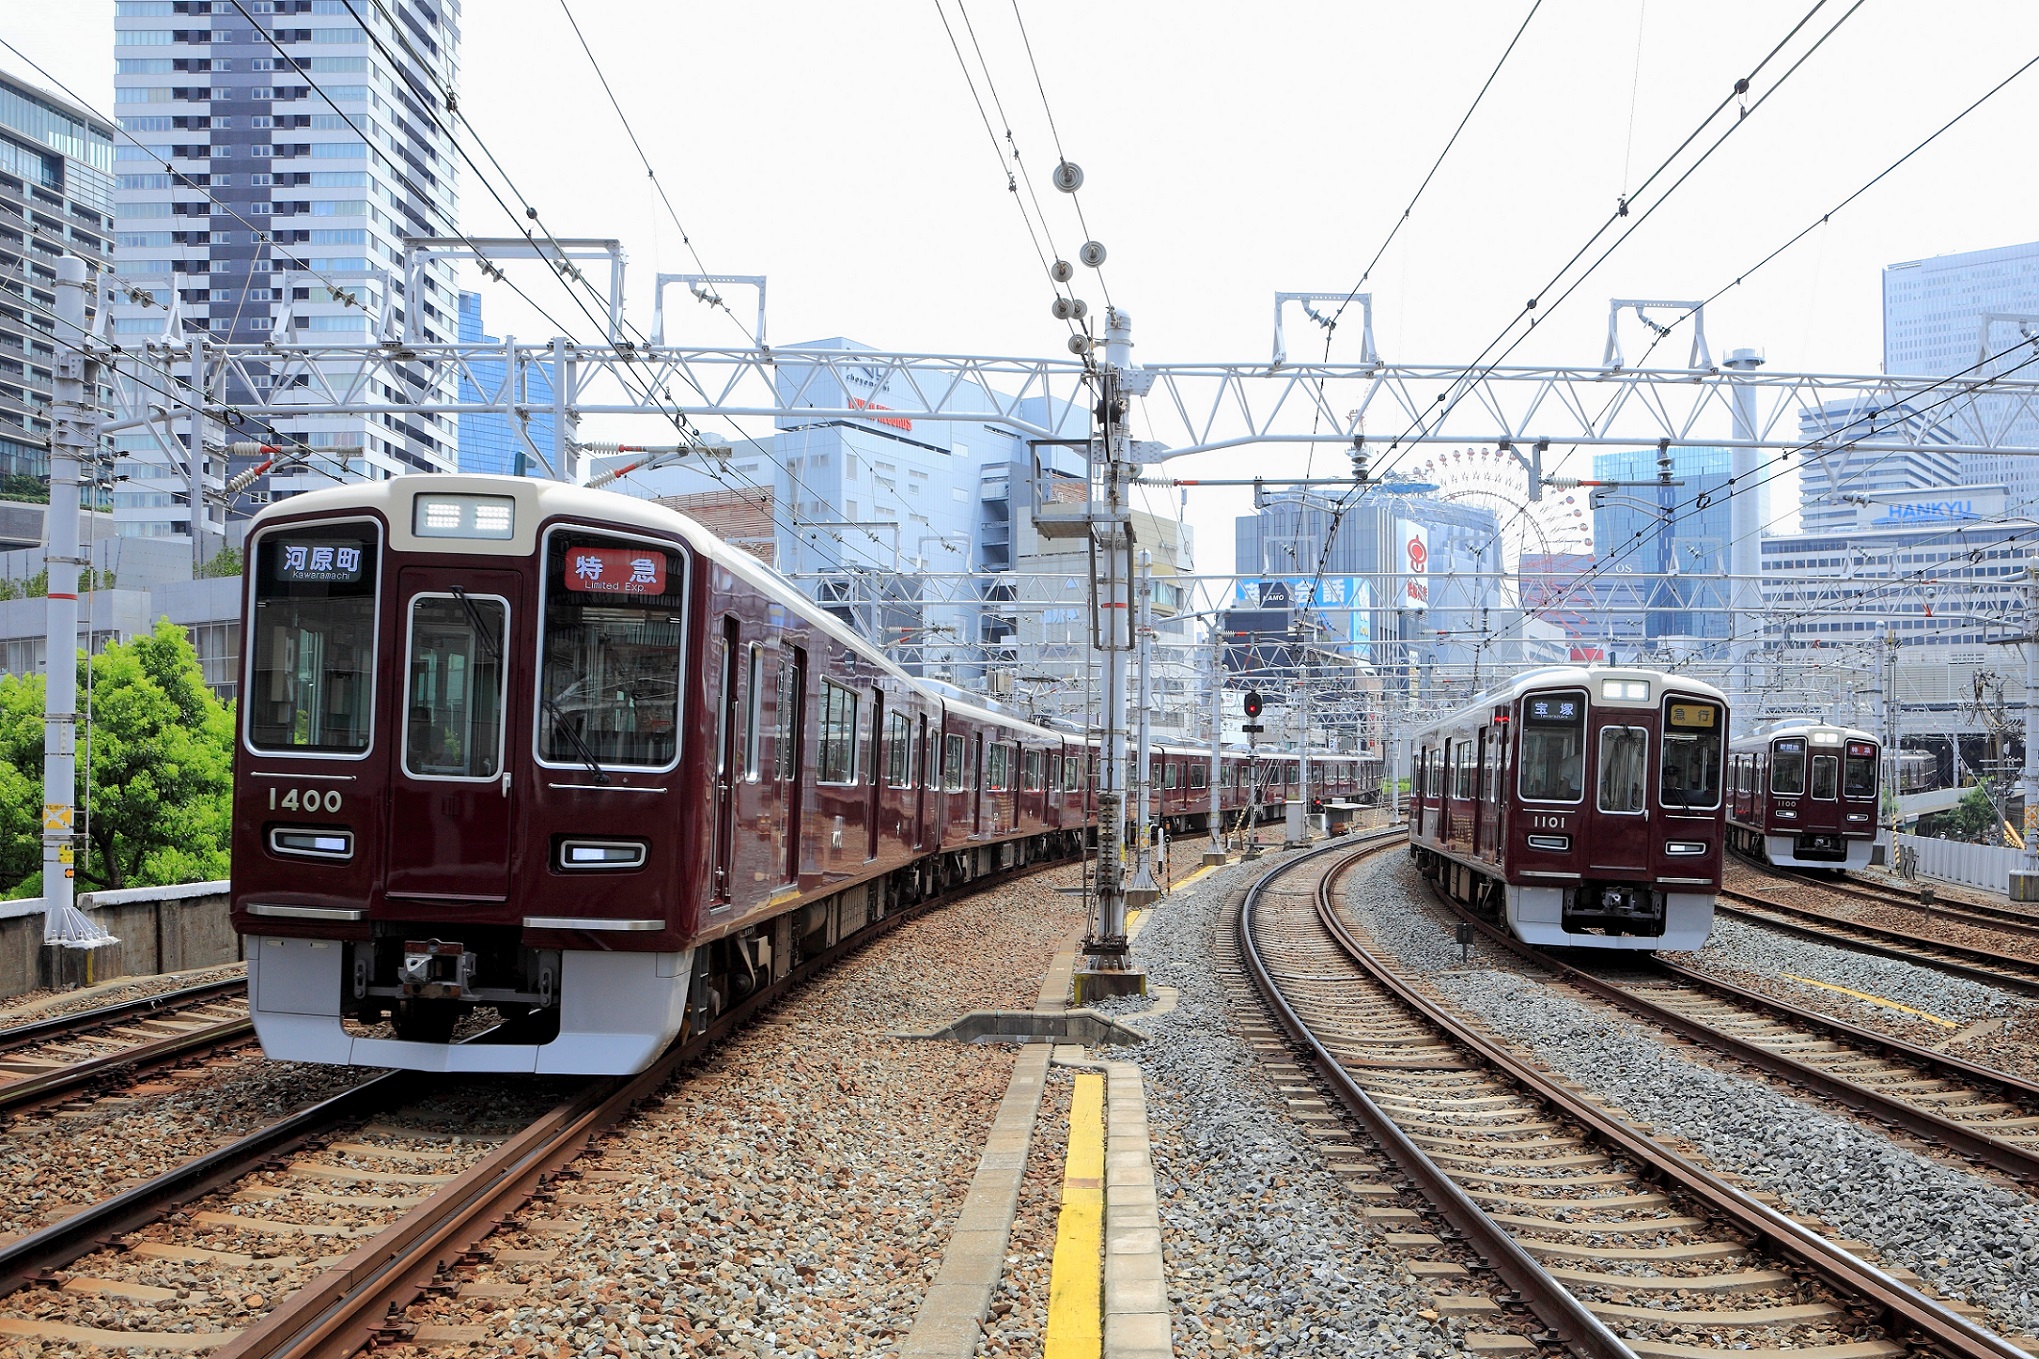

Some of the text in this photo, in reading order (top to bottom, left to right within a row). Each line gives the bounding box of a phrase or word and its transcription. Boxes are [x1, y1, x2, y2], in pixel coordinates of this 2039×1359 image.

[1889, 500, 1971, 518] HANKYU
[283, 545, 361, 572] 河原町
[575, 555, 657, 584] 特急
[1615, 563, 1632, 573] OS
[293, 571, 350, 580] Kawaramachi
[585, 580, 647, 593] Limited Exp.
[1534, 701, 1574, 716] 宝塚
[1673, 708, 1710, 721] 急行
[269, 787, 342, 813] 1400
[1534, 816, 1565, 828] 1101
